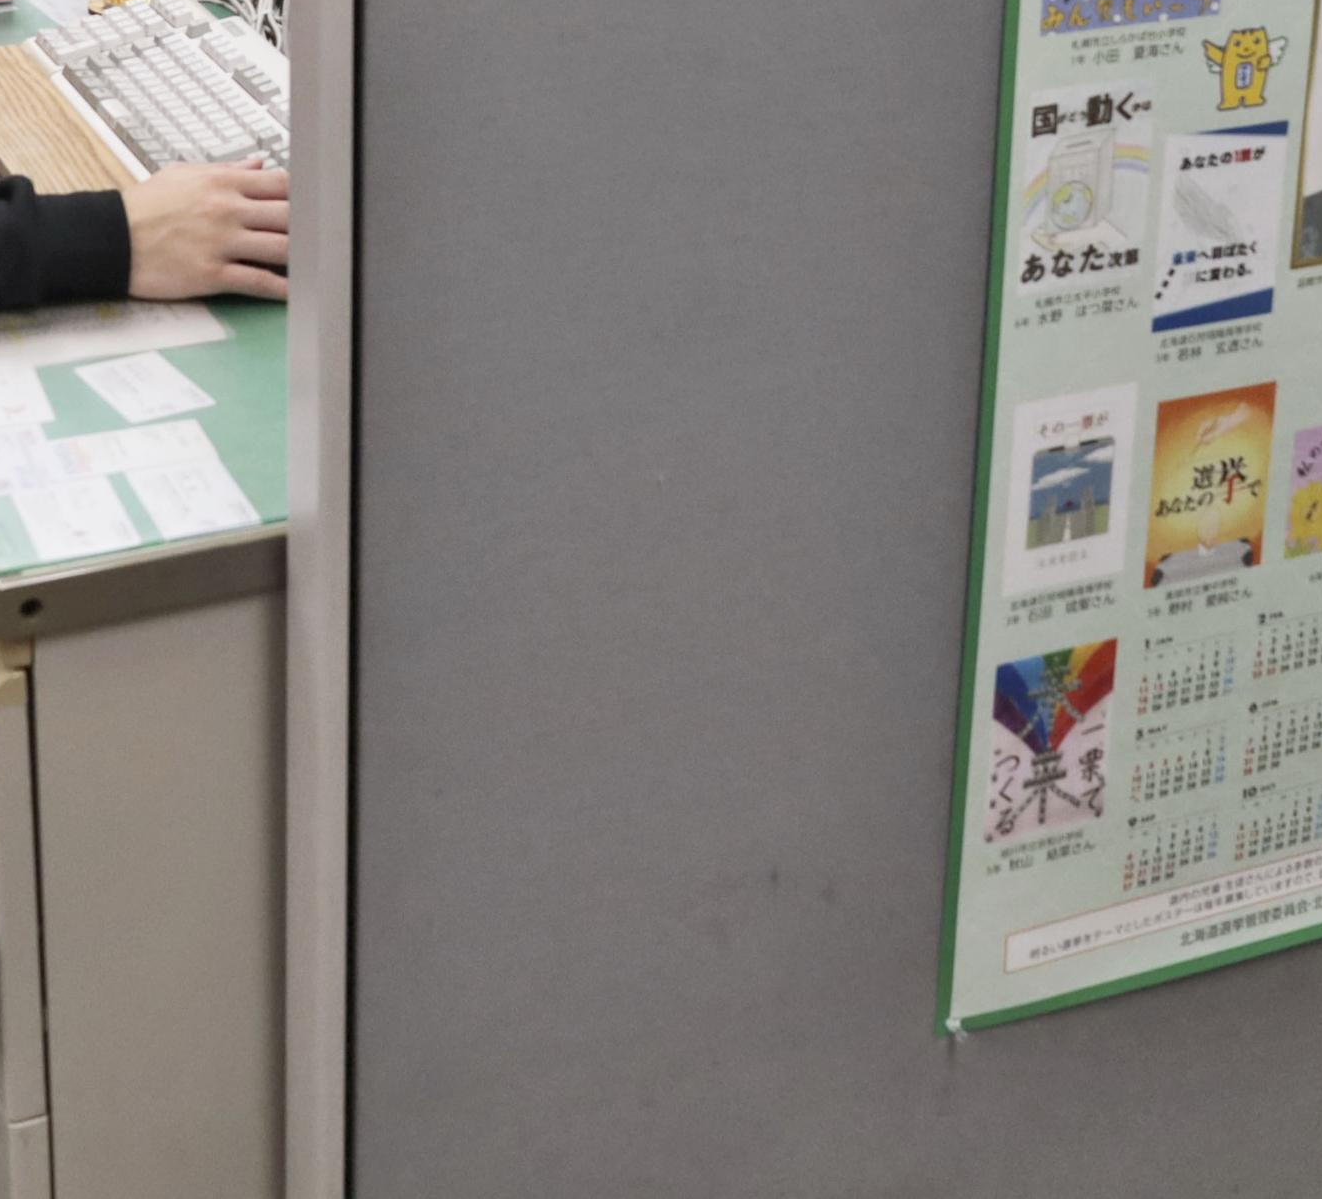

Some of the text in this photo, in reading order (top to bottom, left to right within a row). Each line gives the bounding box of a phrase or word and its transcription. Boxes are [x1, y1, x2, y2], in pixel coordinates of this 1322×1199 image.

[1021, 244, 1140, 284] あなた次第
[1038, 410, 1110, 438] その一票が
